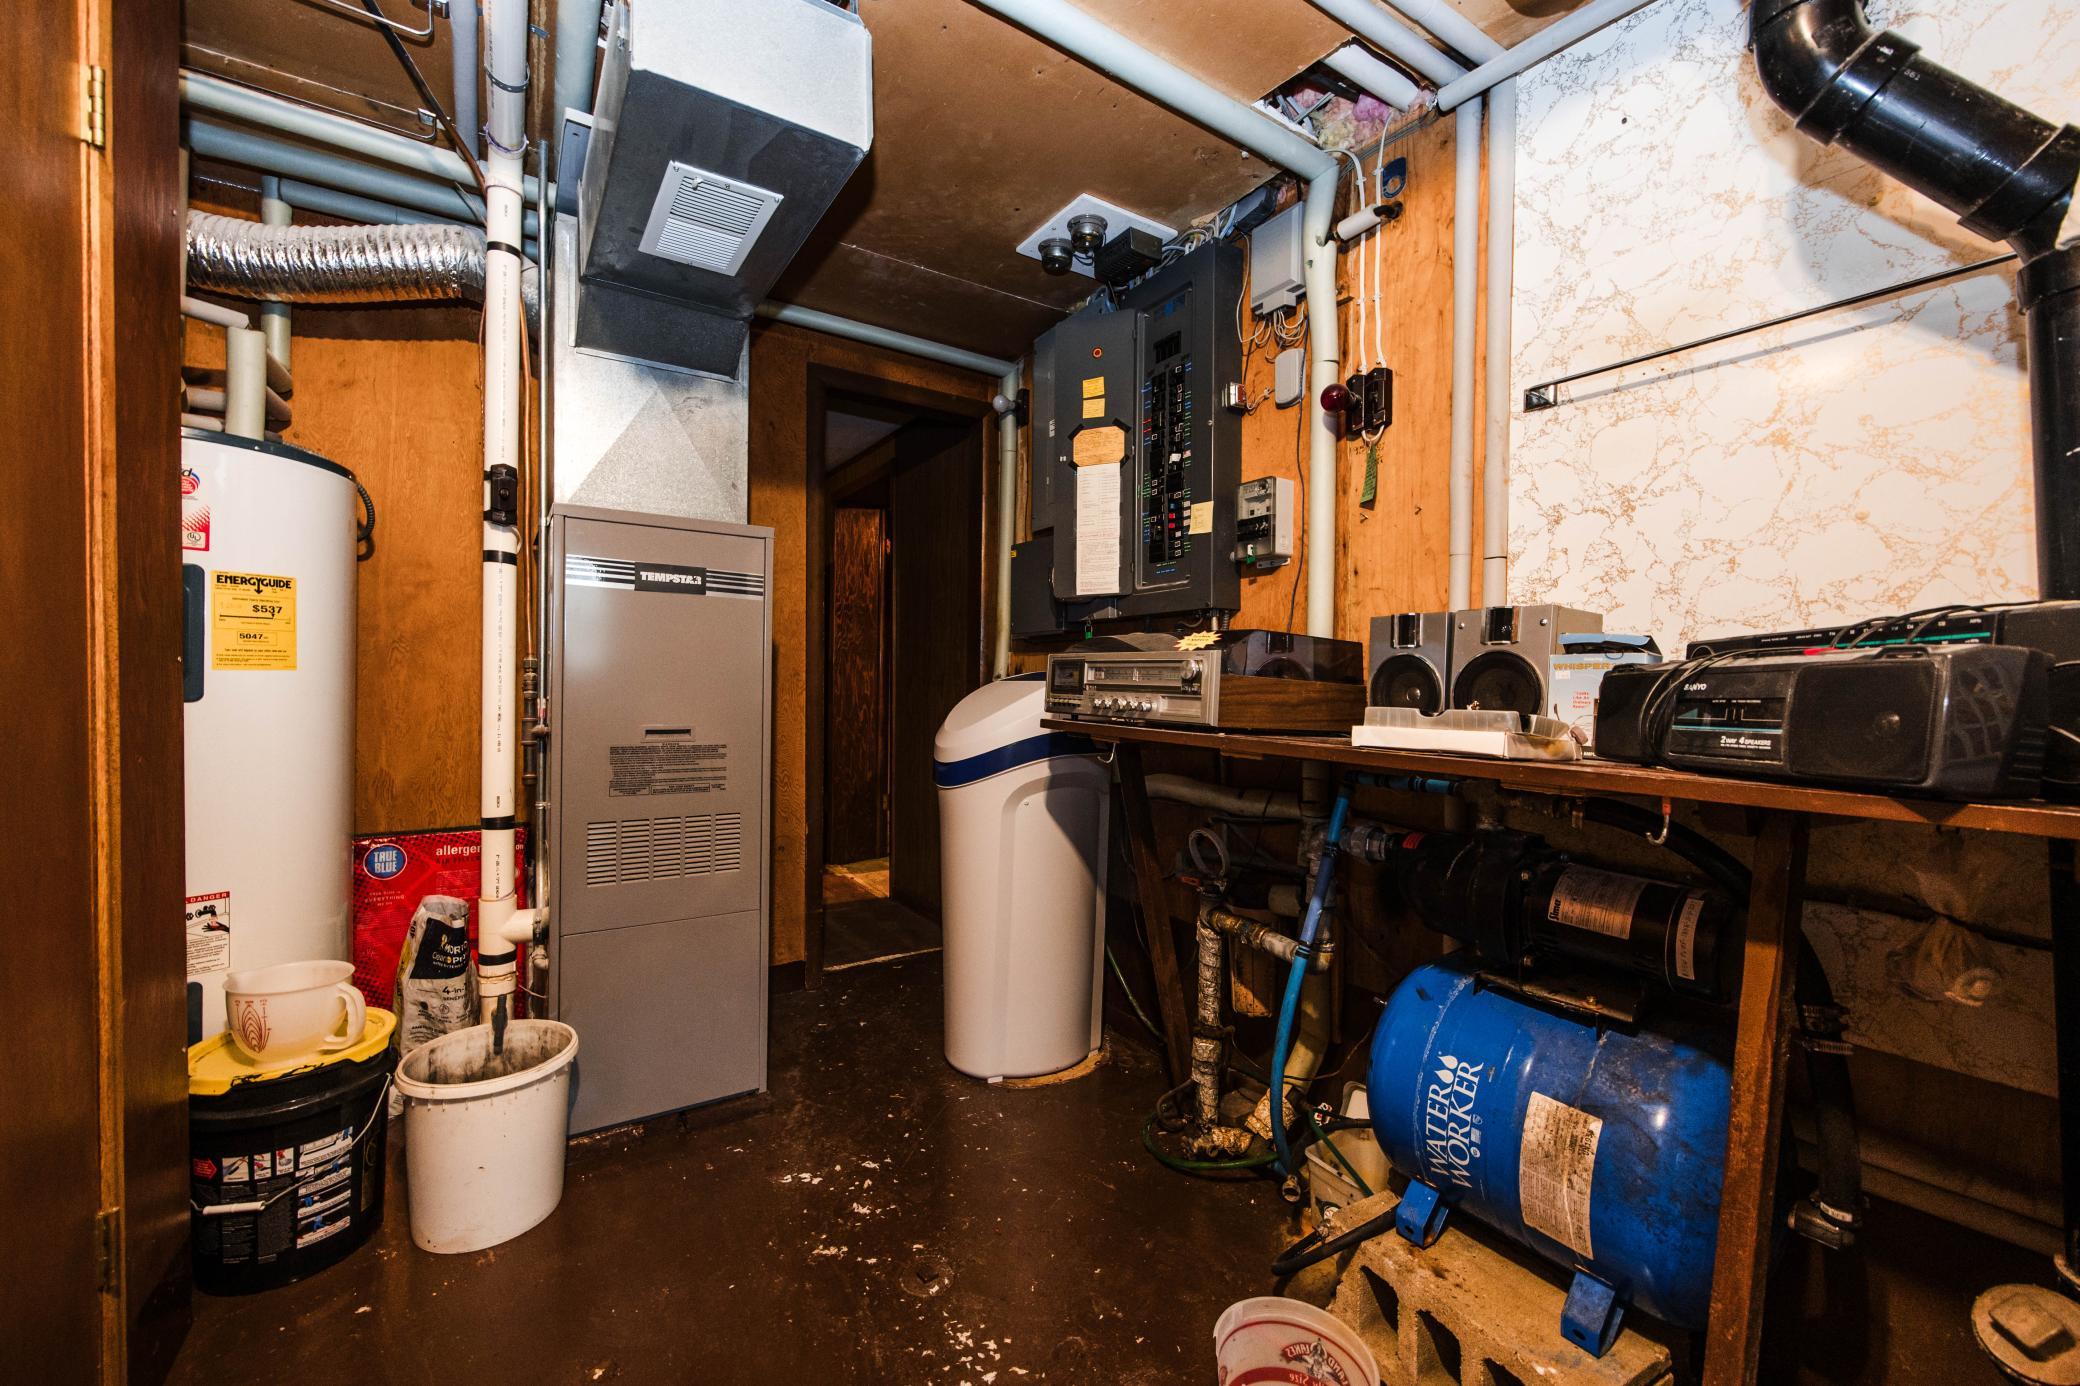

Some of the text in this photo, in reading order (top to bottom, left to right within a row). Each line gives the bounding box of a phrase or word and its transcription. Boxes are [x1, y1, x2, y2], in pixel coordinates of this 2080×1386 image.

[216, 574, 292, 592] ENERGYGUIDE
[252, 604, 283, 615] $537
[239, 632, 263, 640] 5047
[1684, 683, 1707, 691] SANYO
[374, 850, 398, 862] TRUE
[374, 862, 397, 873] BLUE
[190, 892, 227, 903] DANGER
[1426, 1084, 1453, 1176] WATER
[1447, 1061, 1484, 1188] WORKER
